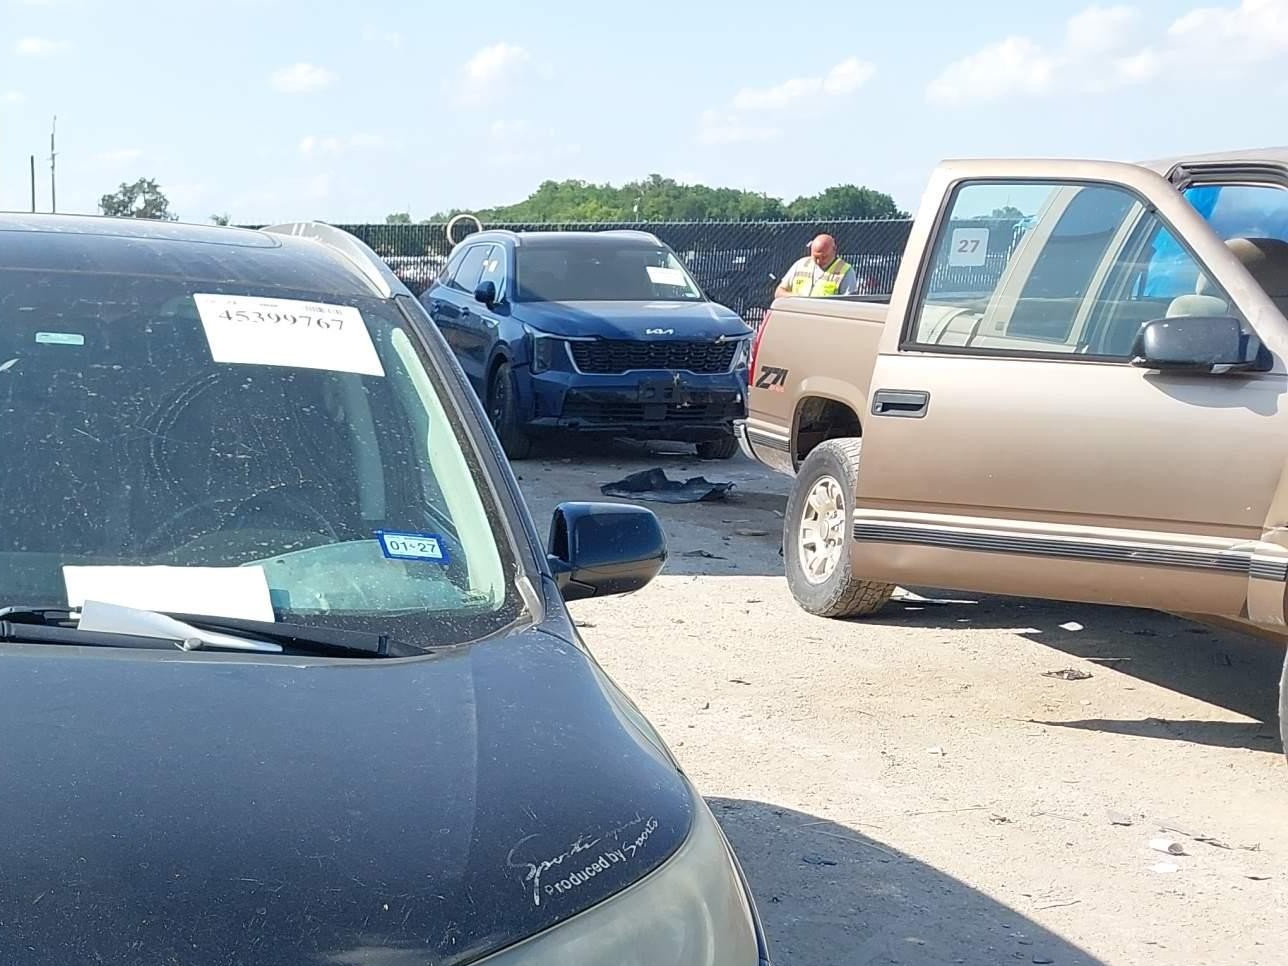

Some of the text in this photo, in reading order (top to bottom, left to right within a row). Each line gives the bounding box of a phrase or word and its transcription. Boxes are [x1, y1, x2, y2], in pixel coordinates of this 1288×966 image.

[957, 239, 980, 253] 27
[218, 309, 344, 331] 45399767
[755, 365, 789, 389] Z71
[544, 854, 611, 895] Produced
[604, 847, 626, 862] by
[622, 815, 659, 858] Sports
